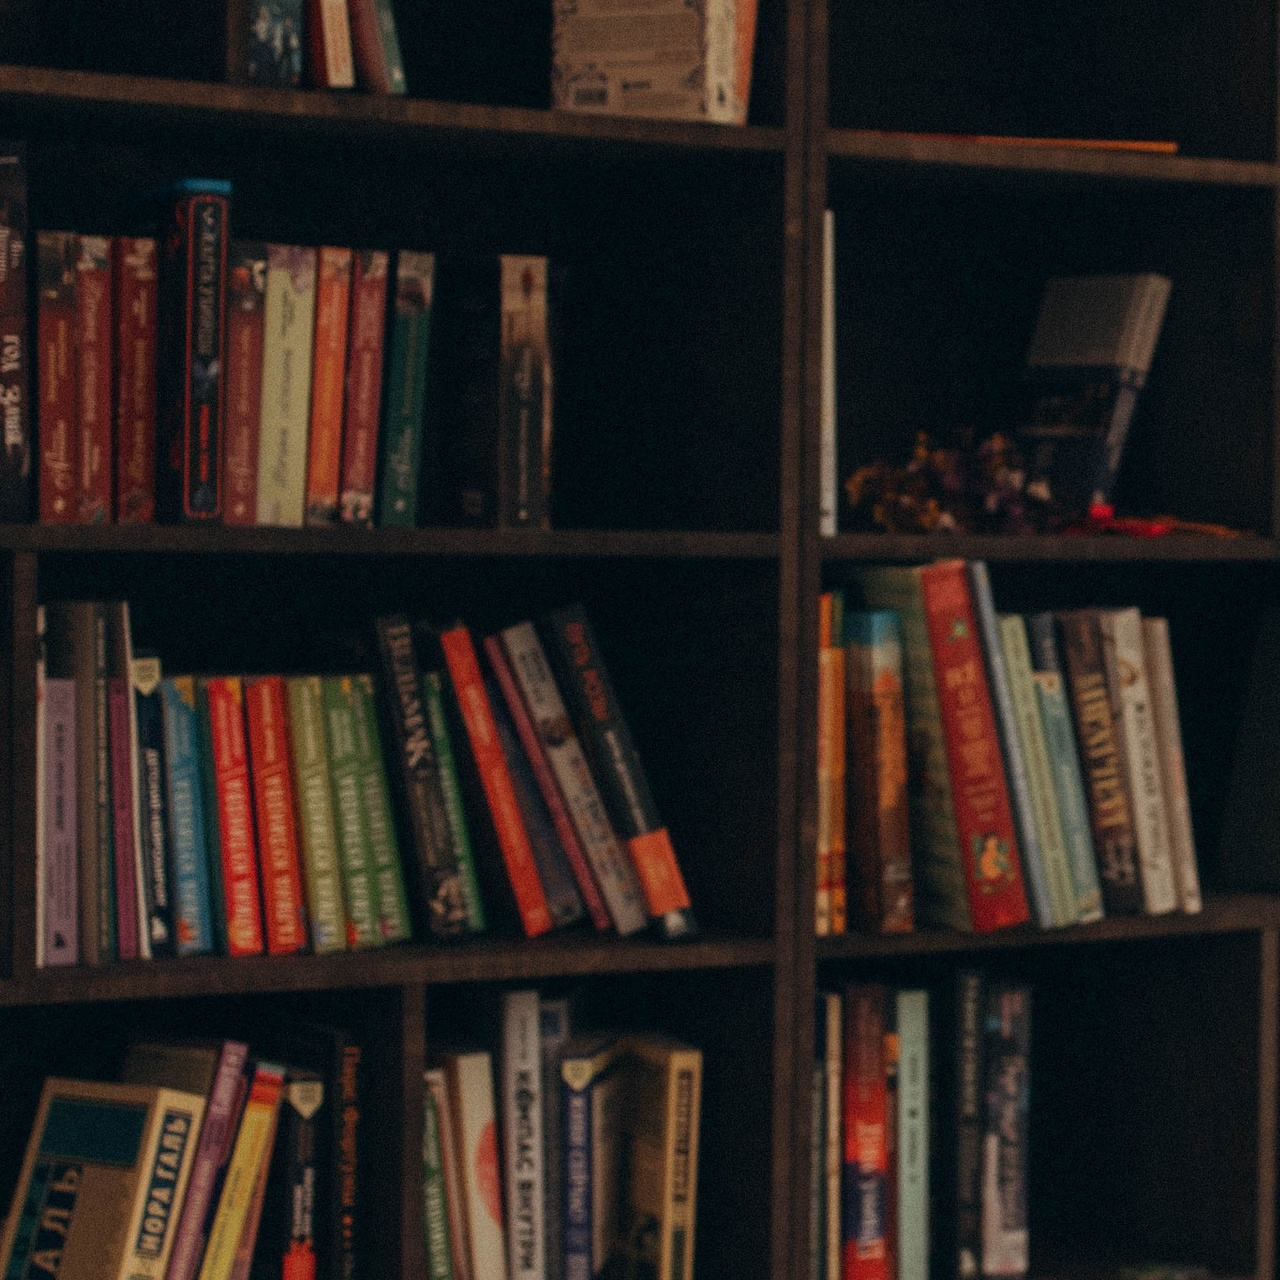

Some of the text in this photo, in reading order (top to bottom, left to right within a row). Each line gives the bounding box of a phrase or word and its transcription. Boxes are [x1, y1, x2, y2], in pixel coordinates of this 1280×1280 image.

[139, 1117, 188, 1253] НОРА ГАЛЬ
[512, 1070, 537, 1269] КОМПАС ВНУТРИ
